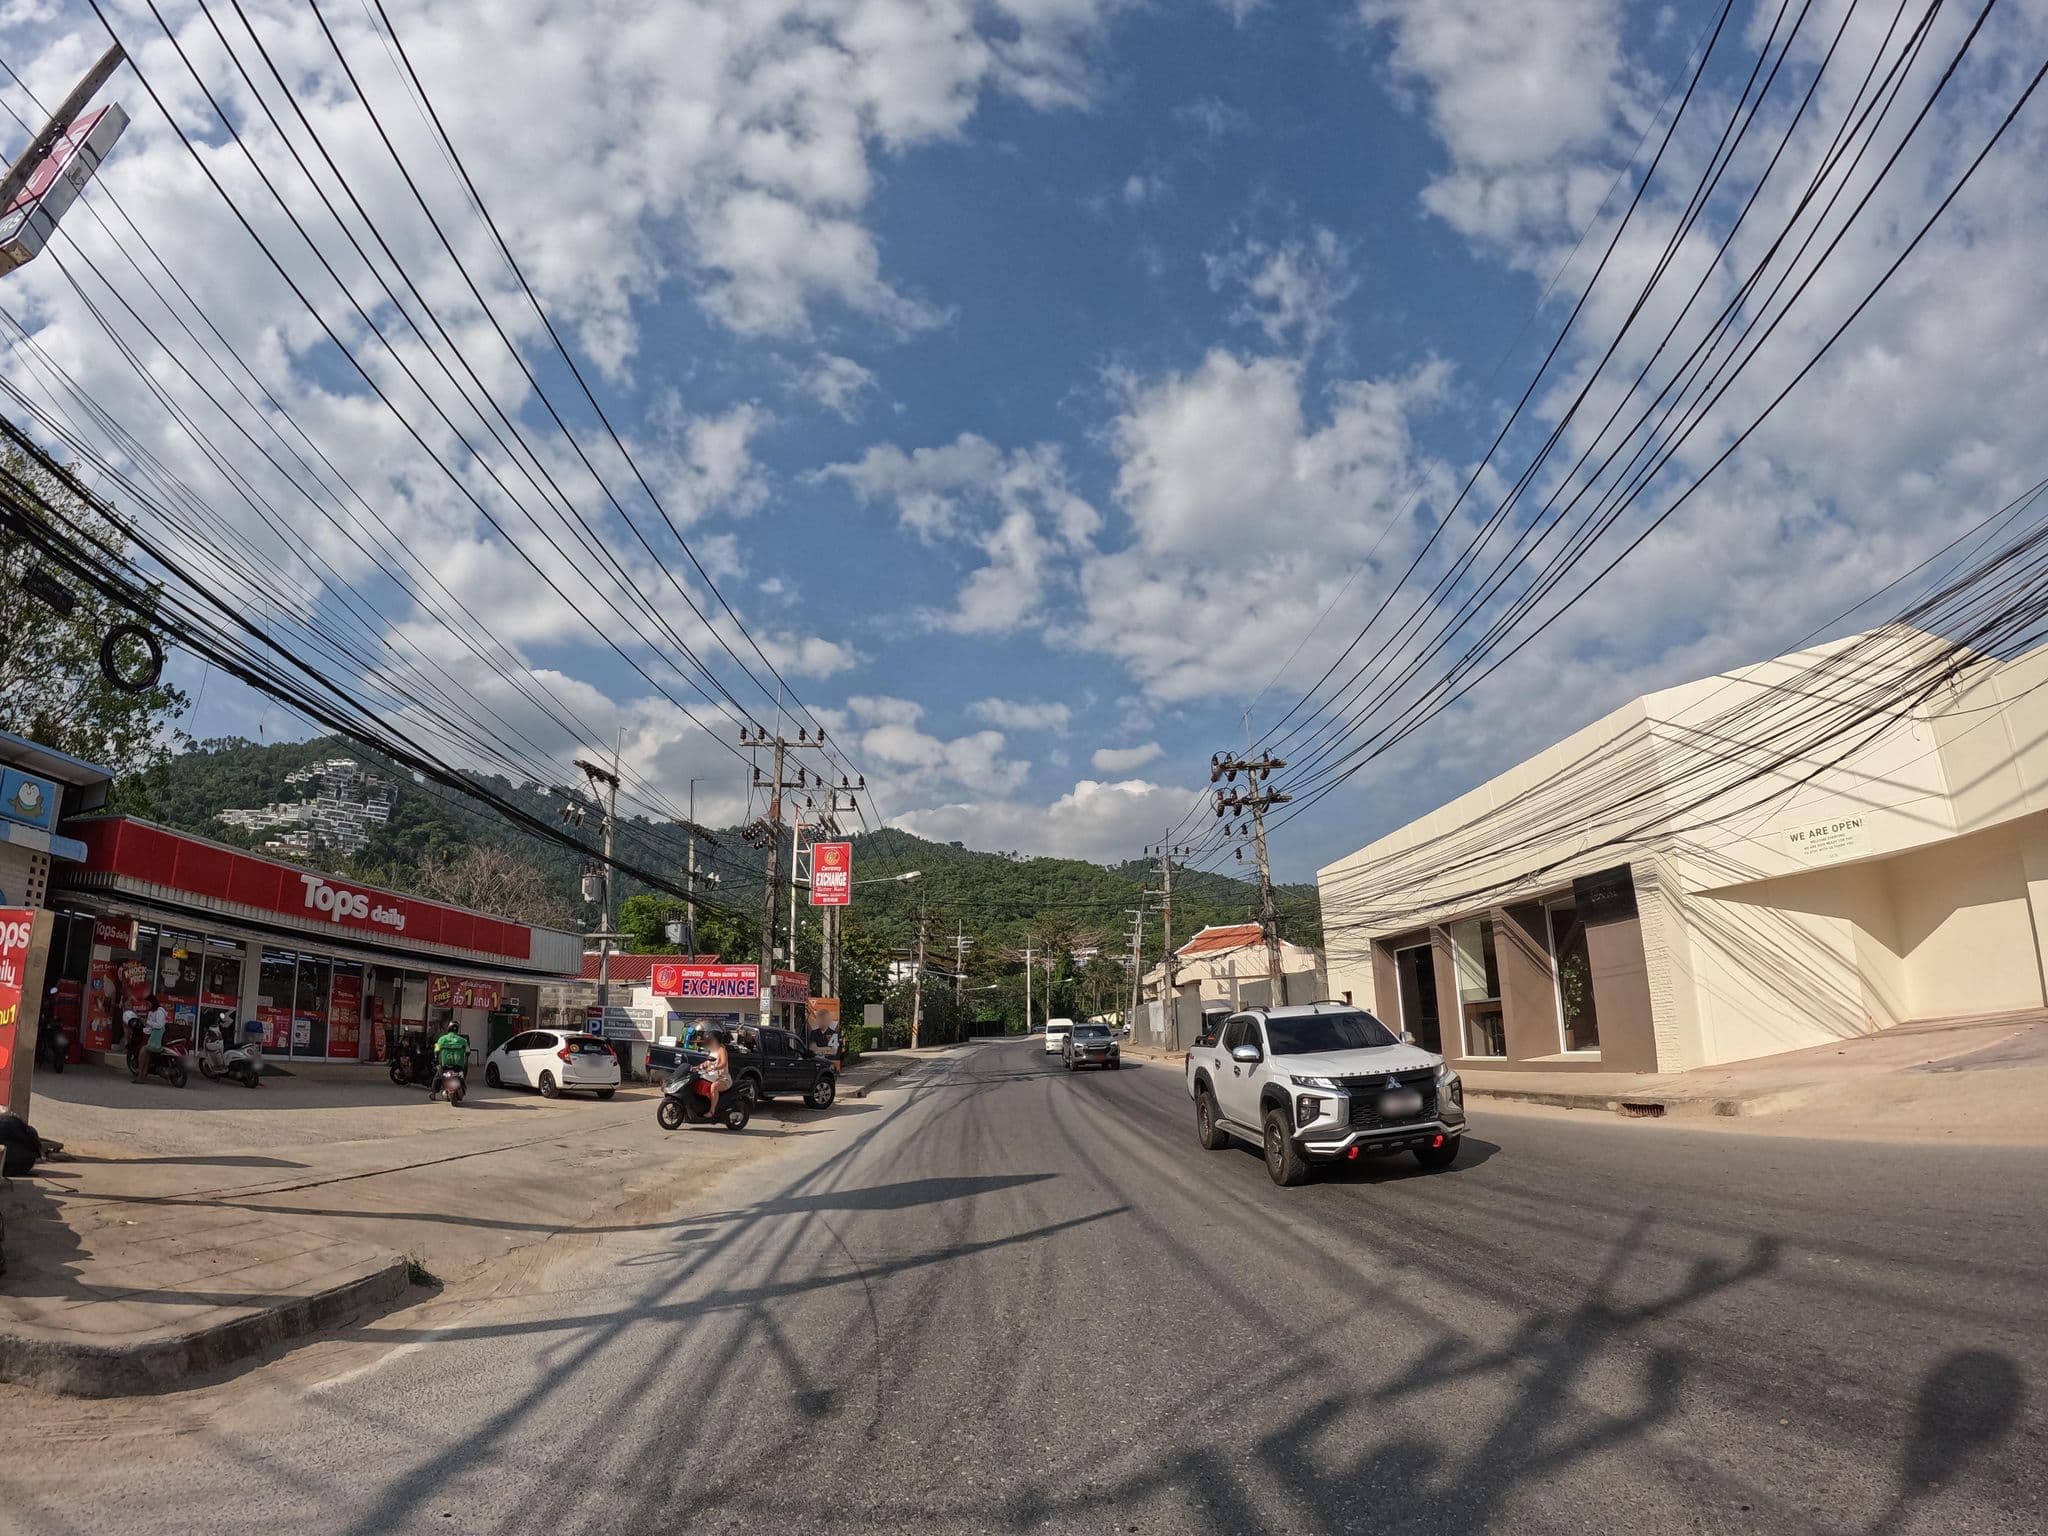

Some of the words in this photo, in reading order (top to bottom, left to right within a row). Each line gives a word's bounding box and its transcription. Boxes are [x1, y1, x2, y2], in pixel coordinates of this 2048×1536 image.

[1789, 832, 1806, 842] WE
[1809, 826, 1829, 839] ARE
[1831, 818, 1863, 833] OPEN!
[816, 871, 847, 887] EXCHANGE
[301, 873, 369, 923] Tops
[370, 904, 406, 931] daily
[96, 920, 116, 940] Tops
[433, 990, 452, 1002] FREE
[681, 979, 755, 996] EXCHANGE
[588, 1020, 601, 1035] P
